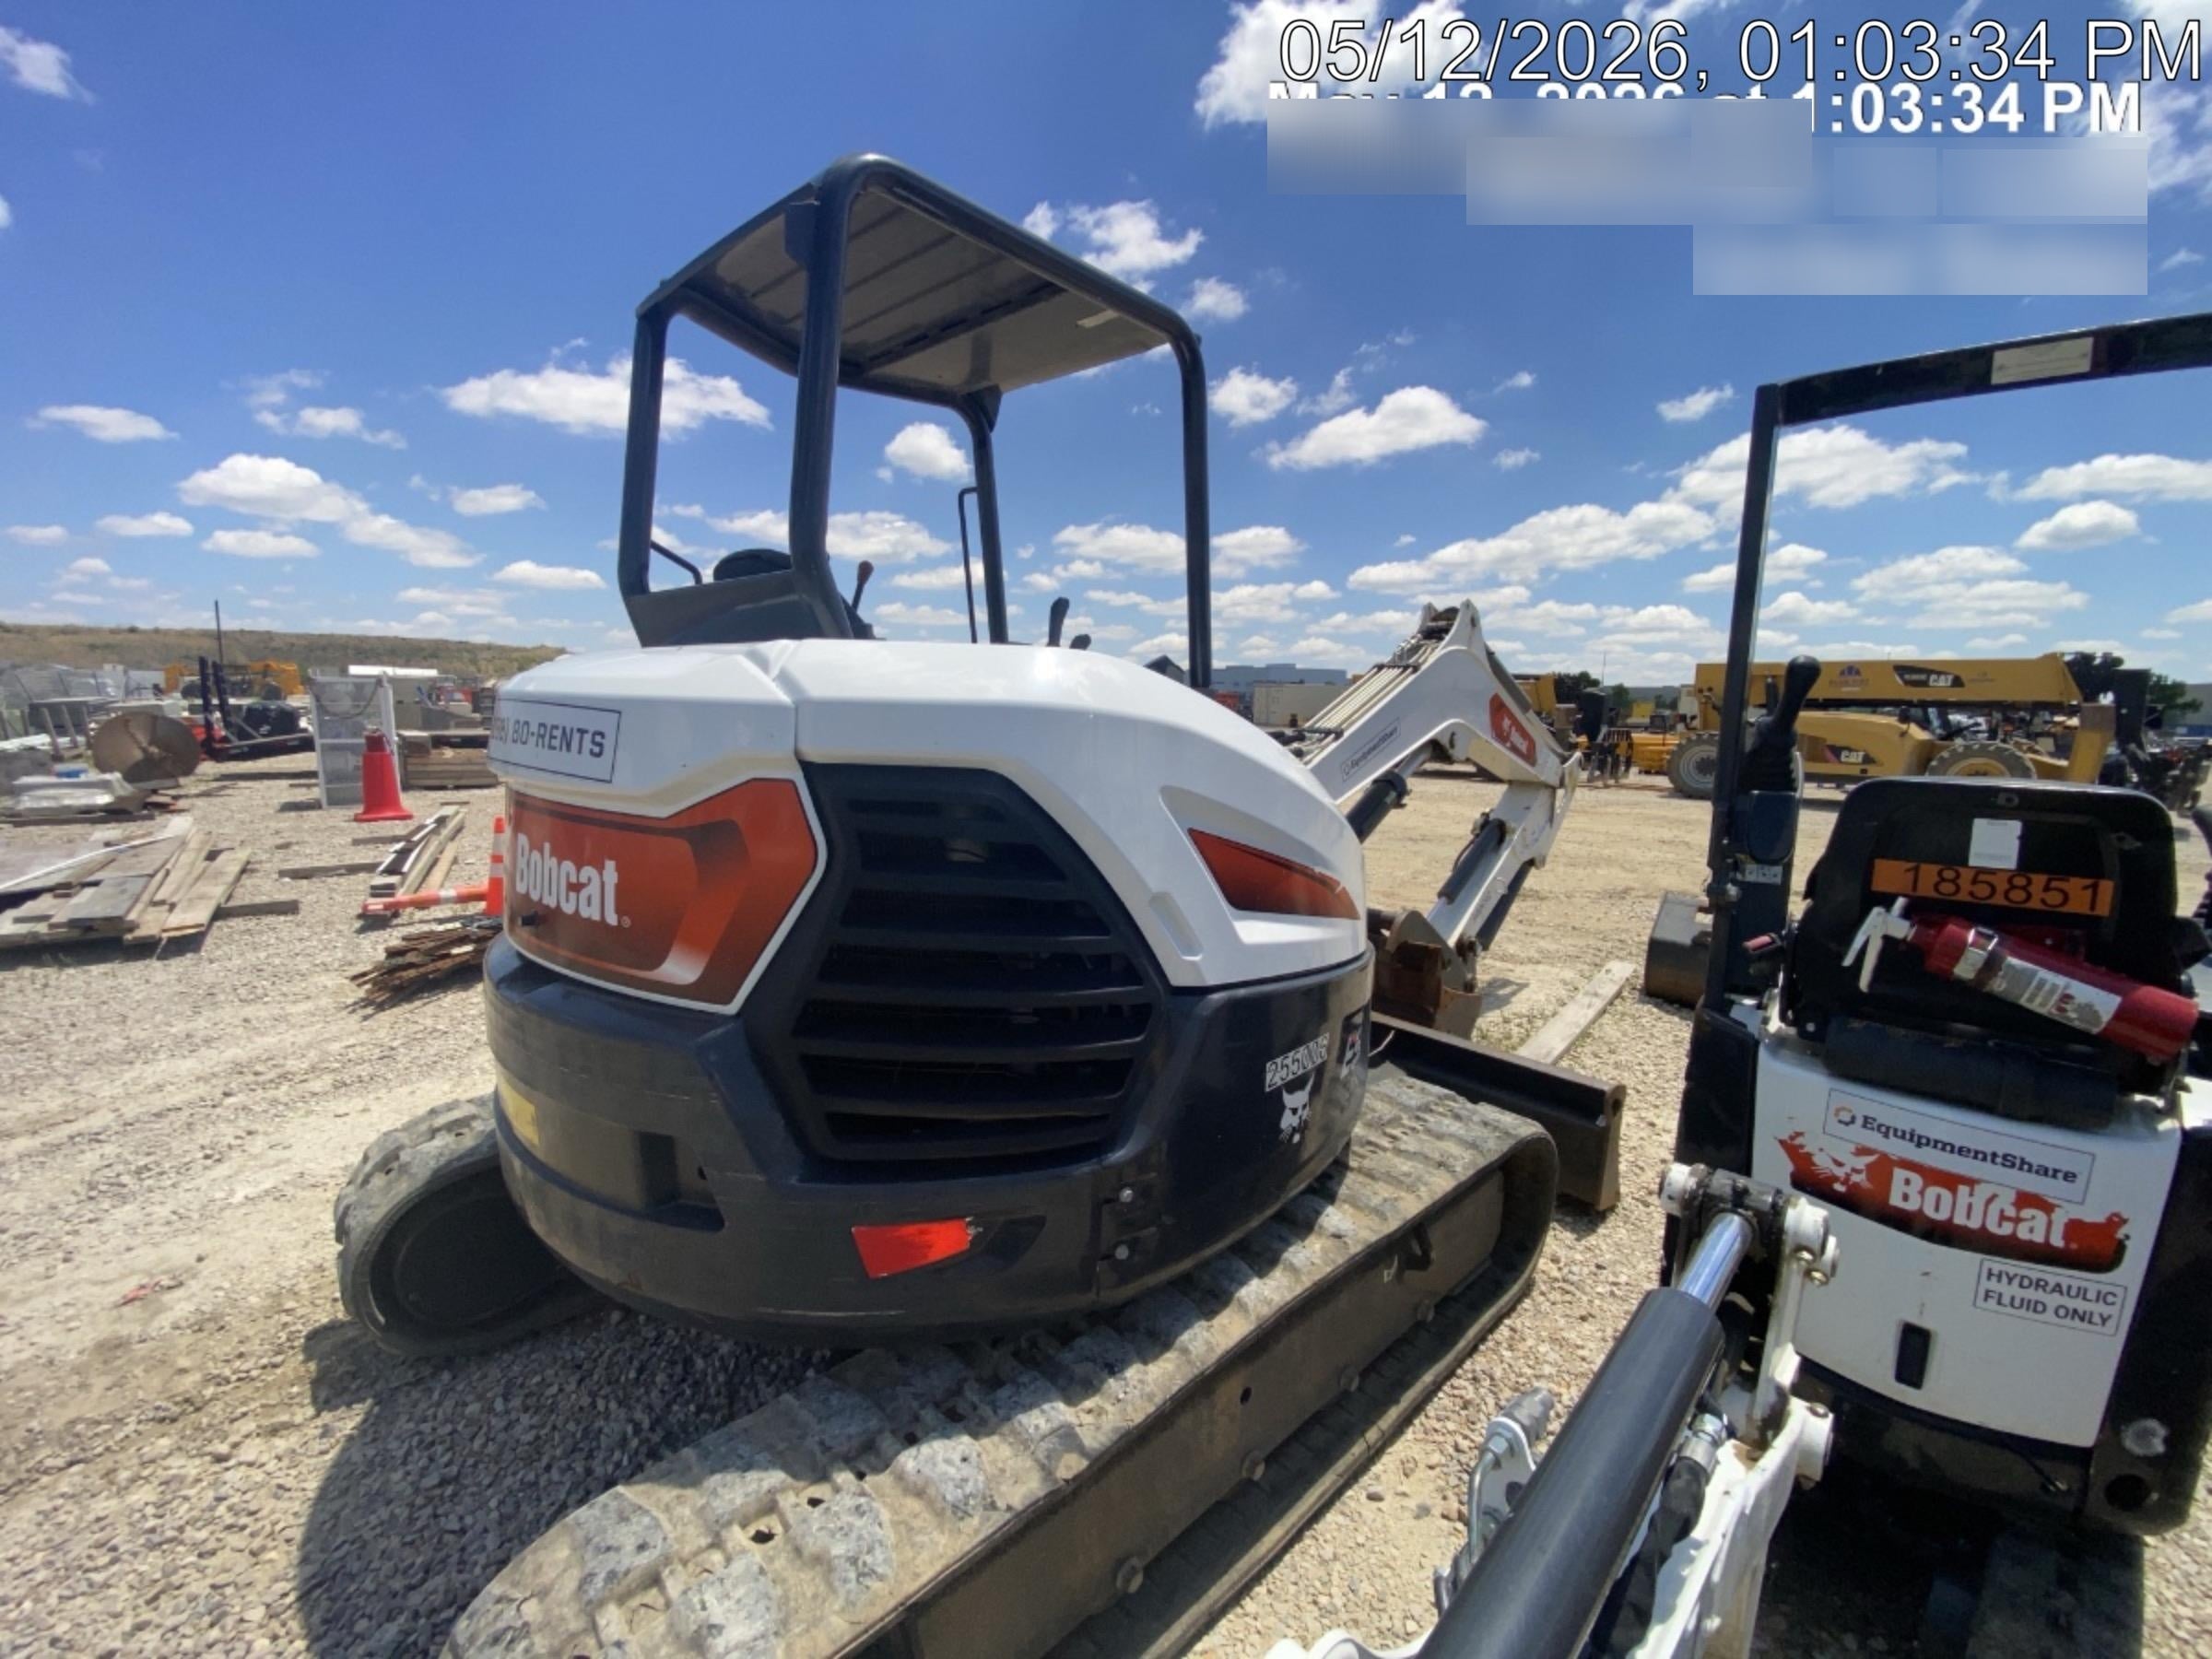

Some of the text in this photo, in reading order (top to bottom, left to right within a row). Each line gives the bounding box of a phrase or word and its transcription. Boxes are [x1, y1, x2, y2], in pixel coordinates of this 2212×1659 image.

[1929, 674, 1954, 687] CAT
[516, 832, 618, 926] Bobcat
[1903, 862, 2100, 912] 185851
[1860, 1114, 2079, 1184] EquipmentShare
[1888, 1167, 2067, 1249] Bobcat
[1983, 1289, 2113, 1328] FLUID ONLY
[1986, 1267, 2118, 1306] HYDRAULIC
